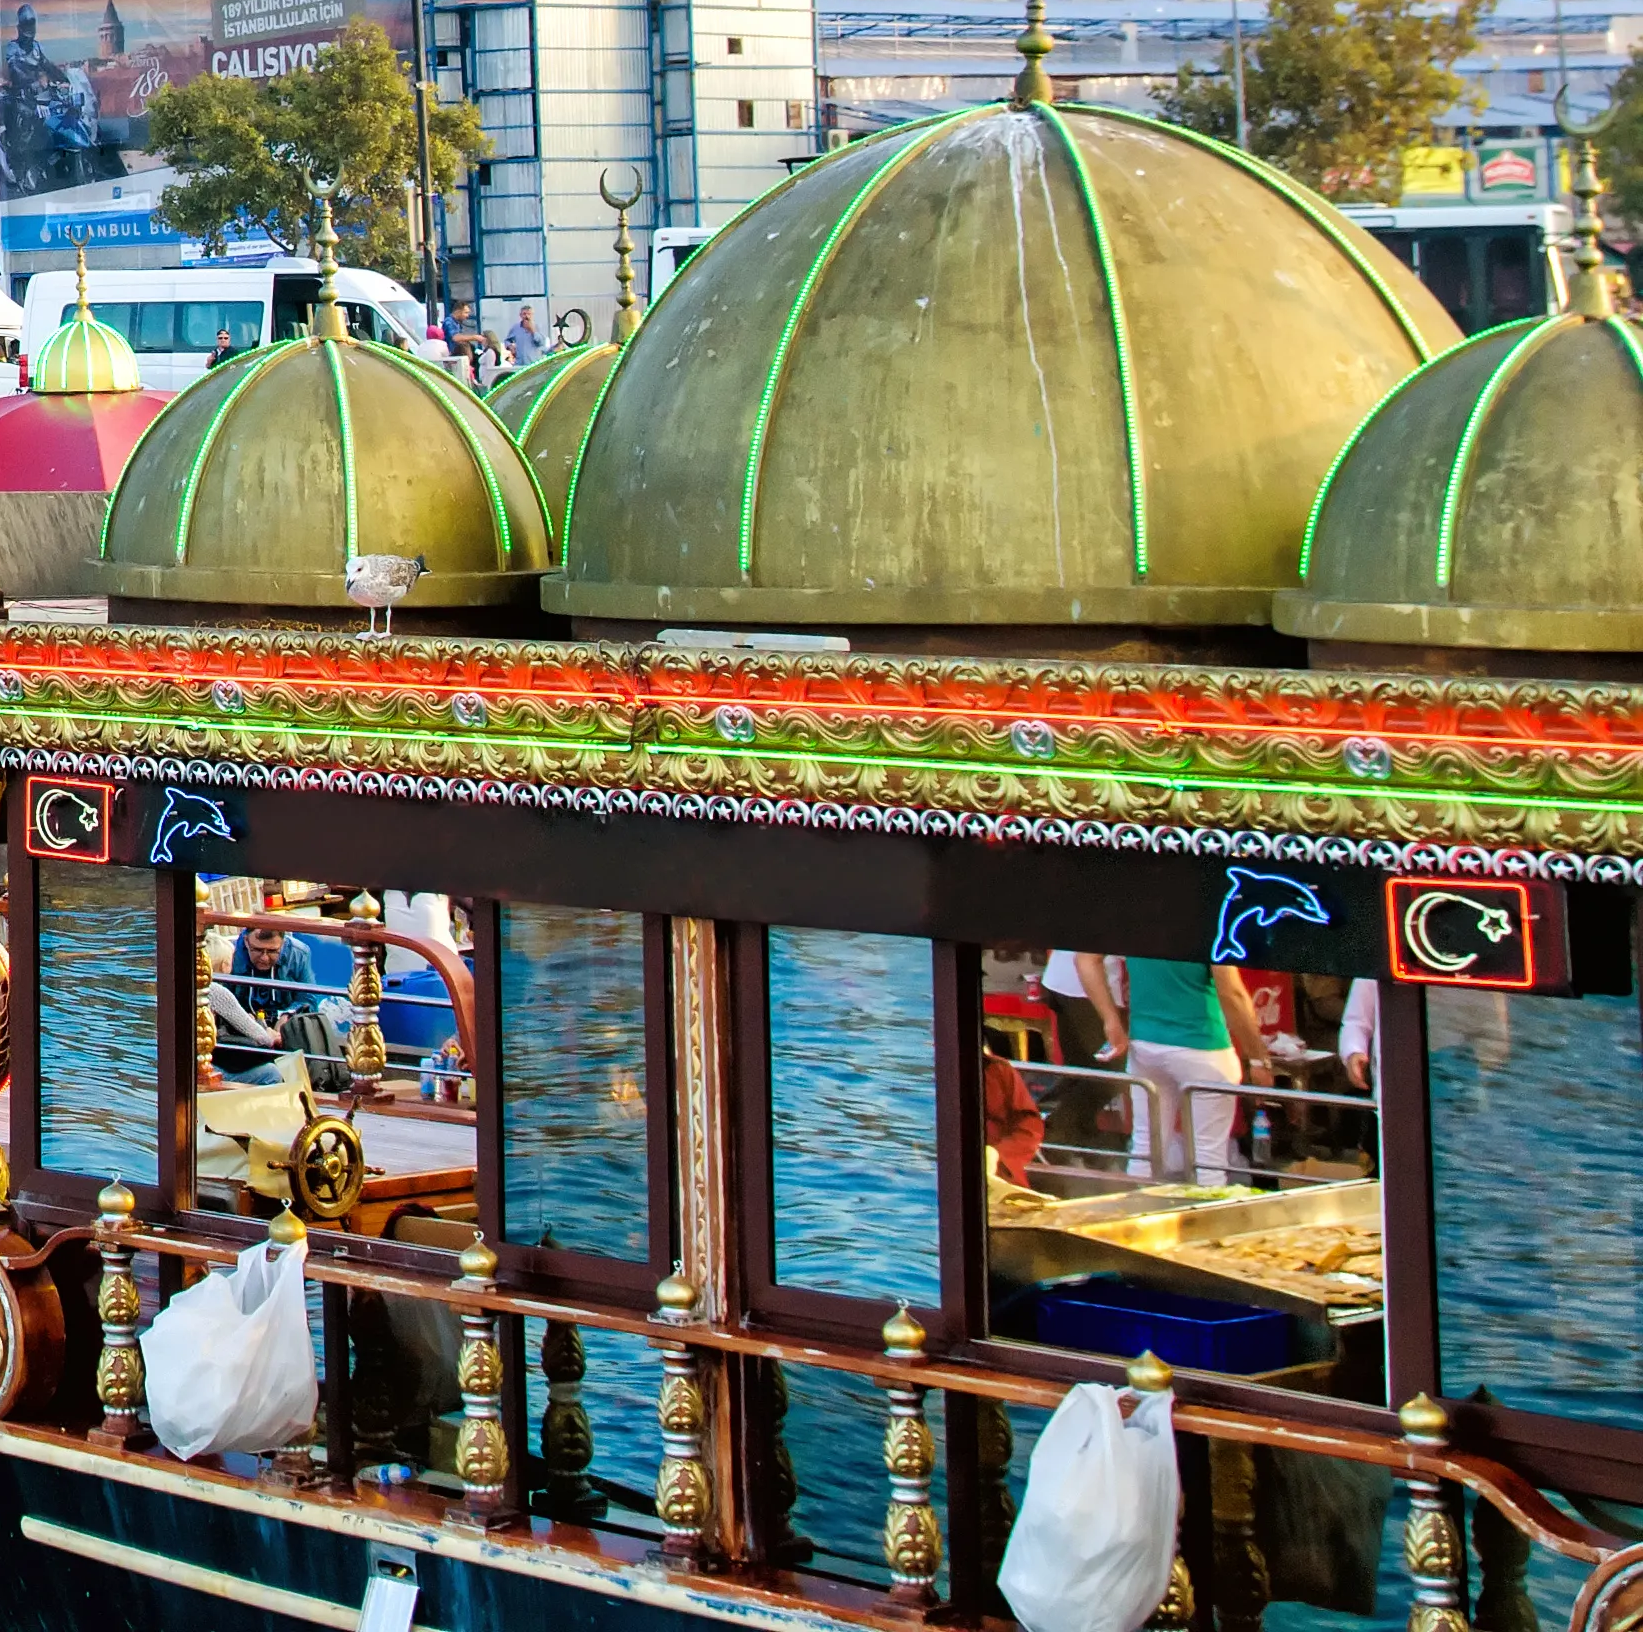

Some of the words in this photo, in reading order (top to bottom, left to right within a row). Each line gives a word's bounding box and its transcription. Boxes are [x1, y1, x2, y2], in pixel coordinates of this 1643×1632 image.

[222, 3, 242, 19] 189
[224, 7, 319, 39] İSTANBULLULAR
[320, 1, 343, 24] İÇİN
